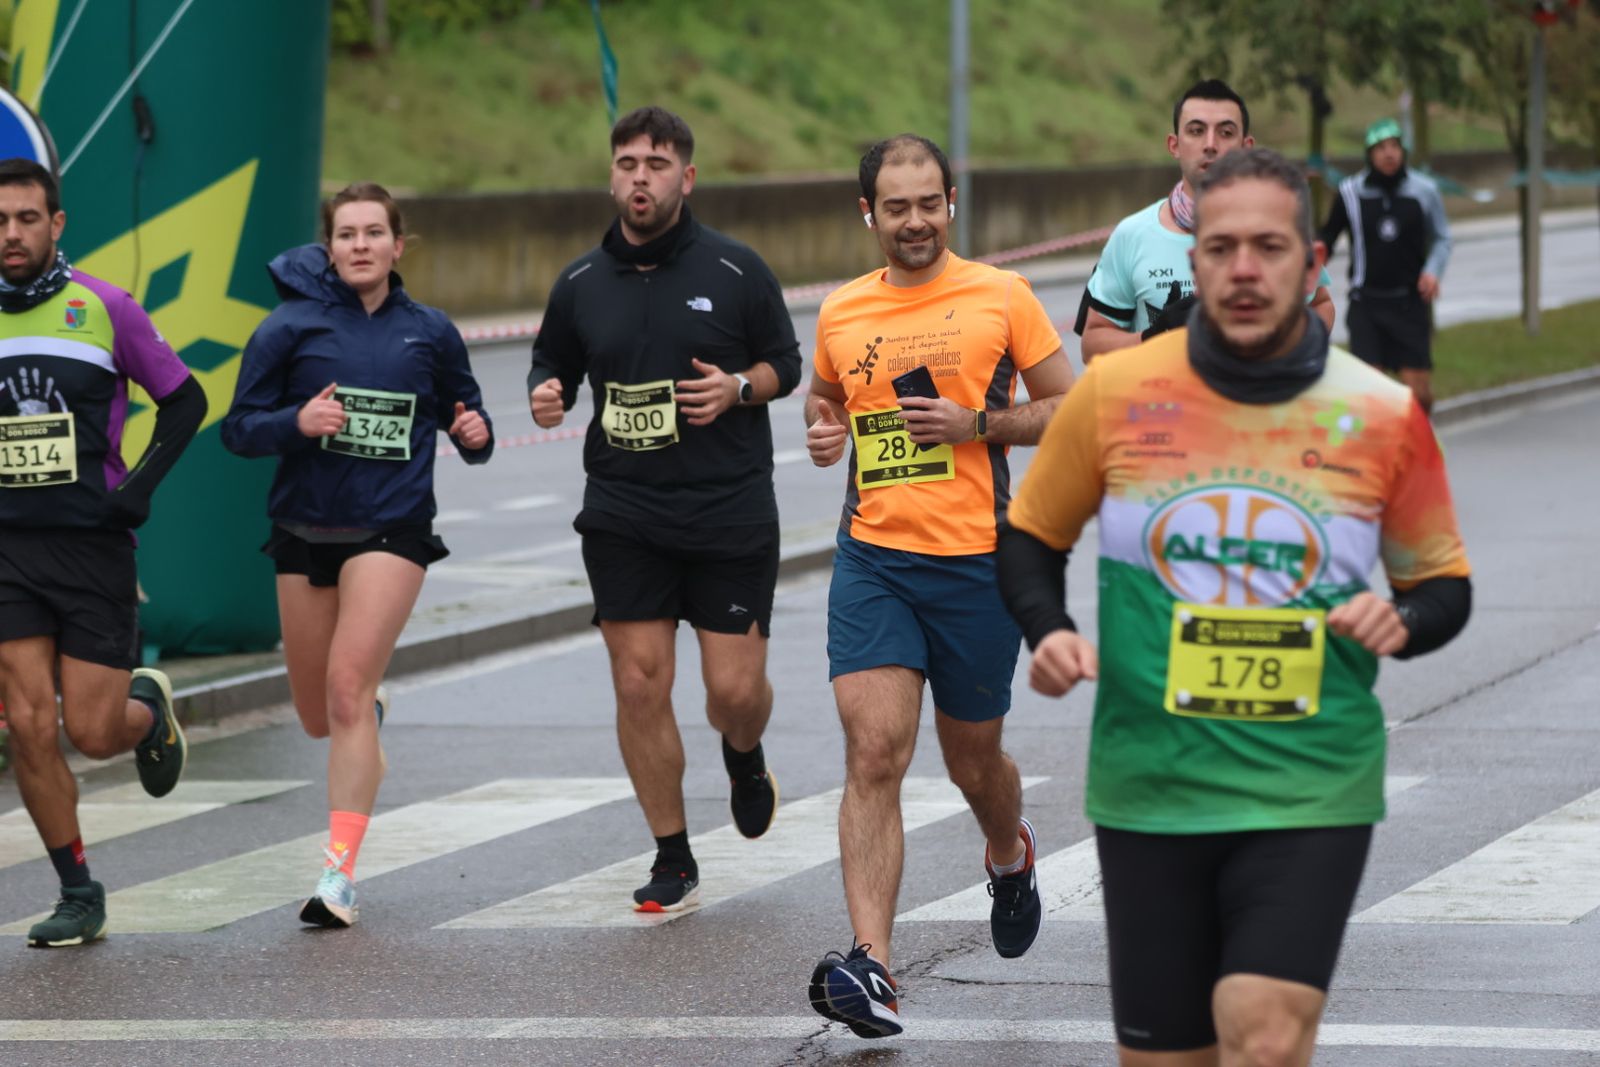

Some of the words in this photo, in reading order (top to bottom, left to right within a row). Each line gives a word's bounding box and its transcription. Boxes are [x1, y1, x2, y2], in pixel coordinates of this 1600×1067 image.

[1148, 268, 1173, 278] XXI
[913, 334, 925, 346] por
[940, 328, 961, 337] salud
[919, 340, 948, 349] deporte
[887, 352, 916, 372] colegio
[928, 347, 961, 367] médicos
[340, 416, 399, 441] 1342
[612, 409, 664, 433] 1300
[878, 418, 893, 428] DON
[1, 443, 62, 468] 1314
[1206, 655, 1282, 690] 178
